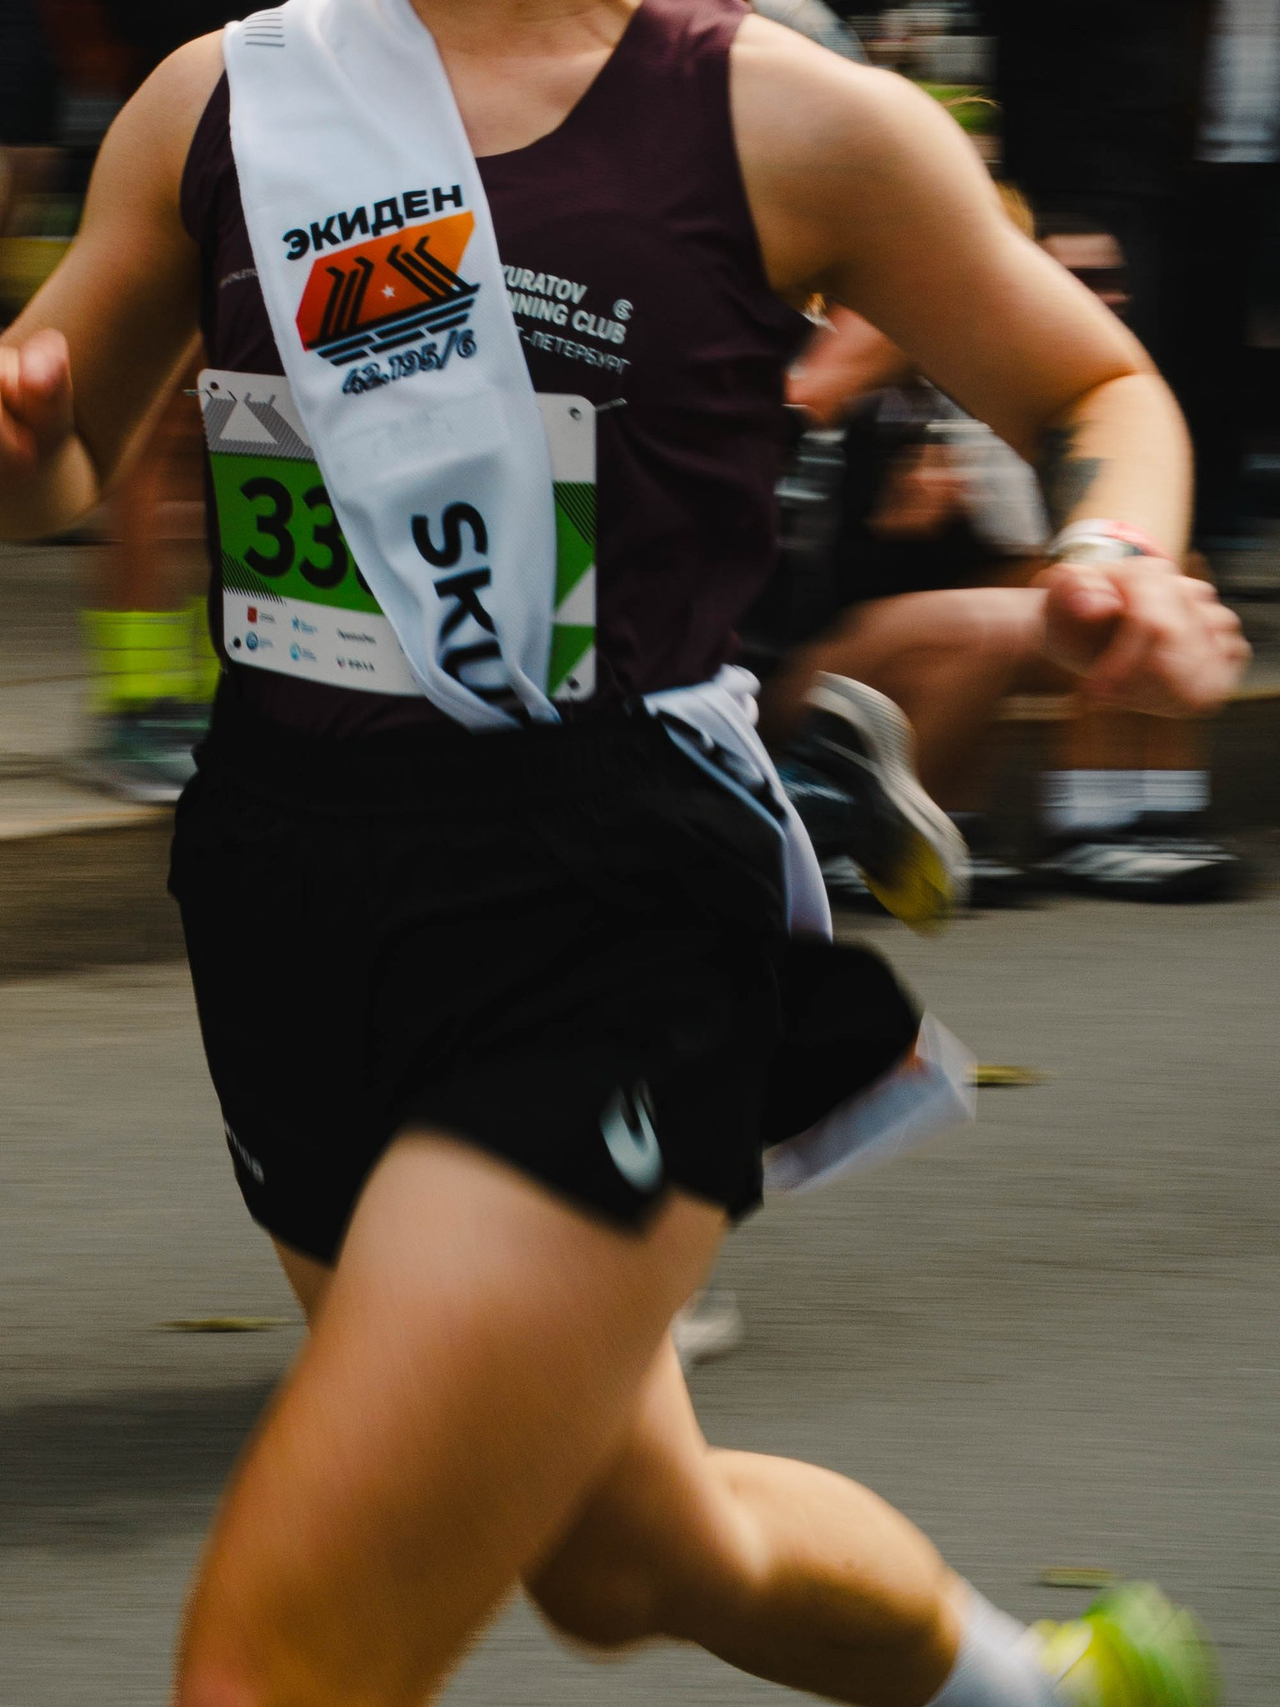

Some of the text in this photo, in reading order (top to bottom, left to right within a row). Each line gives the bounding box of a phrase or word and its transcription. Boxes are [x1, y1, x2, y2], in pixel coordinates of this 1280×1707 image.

[282, 184, 463, 261] ЭКИДЕН
[509, 290, 569, 326] NNING
[572, 310, 627, 345] CLUB
[517, 325, 632, 374] -ПЕТЕРБУРГ
[342, 328, 477, 395] 42.195/6
[239, 476, 373, 594] 33
